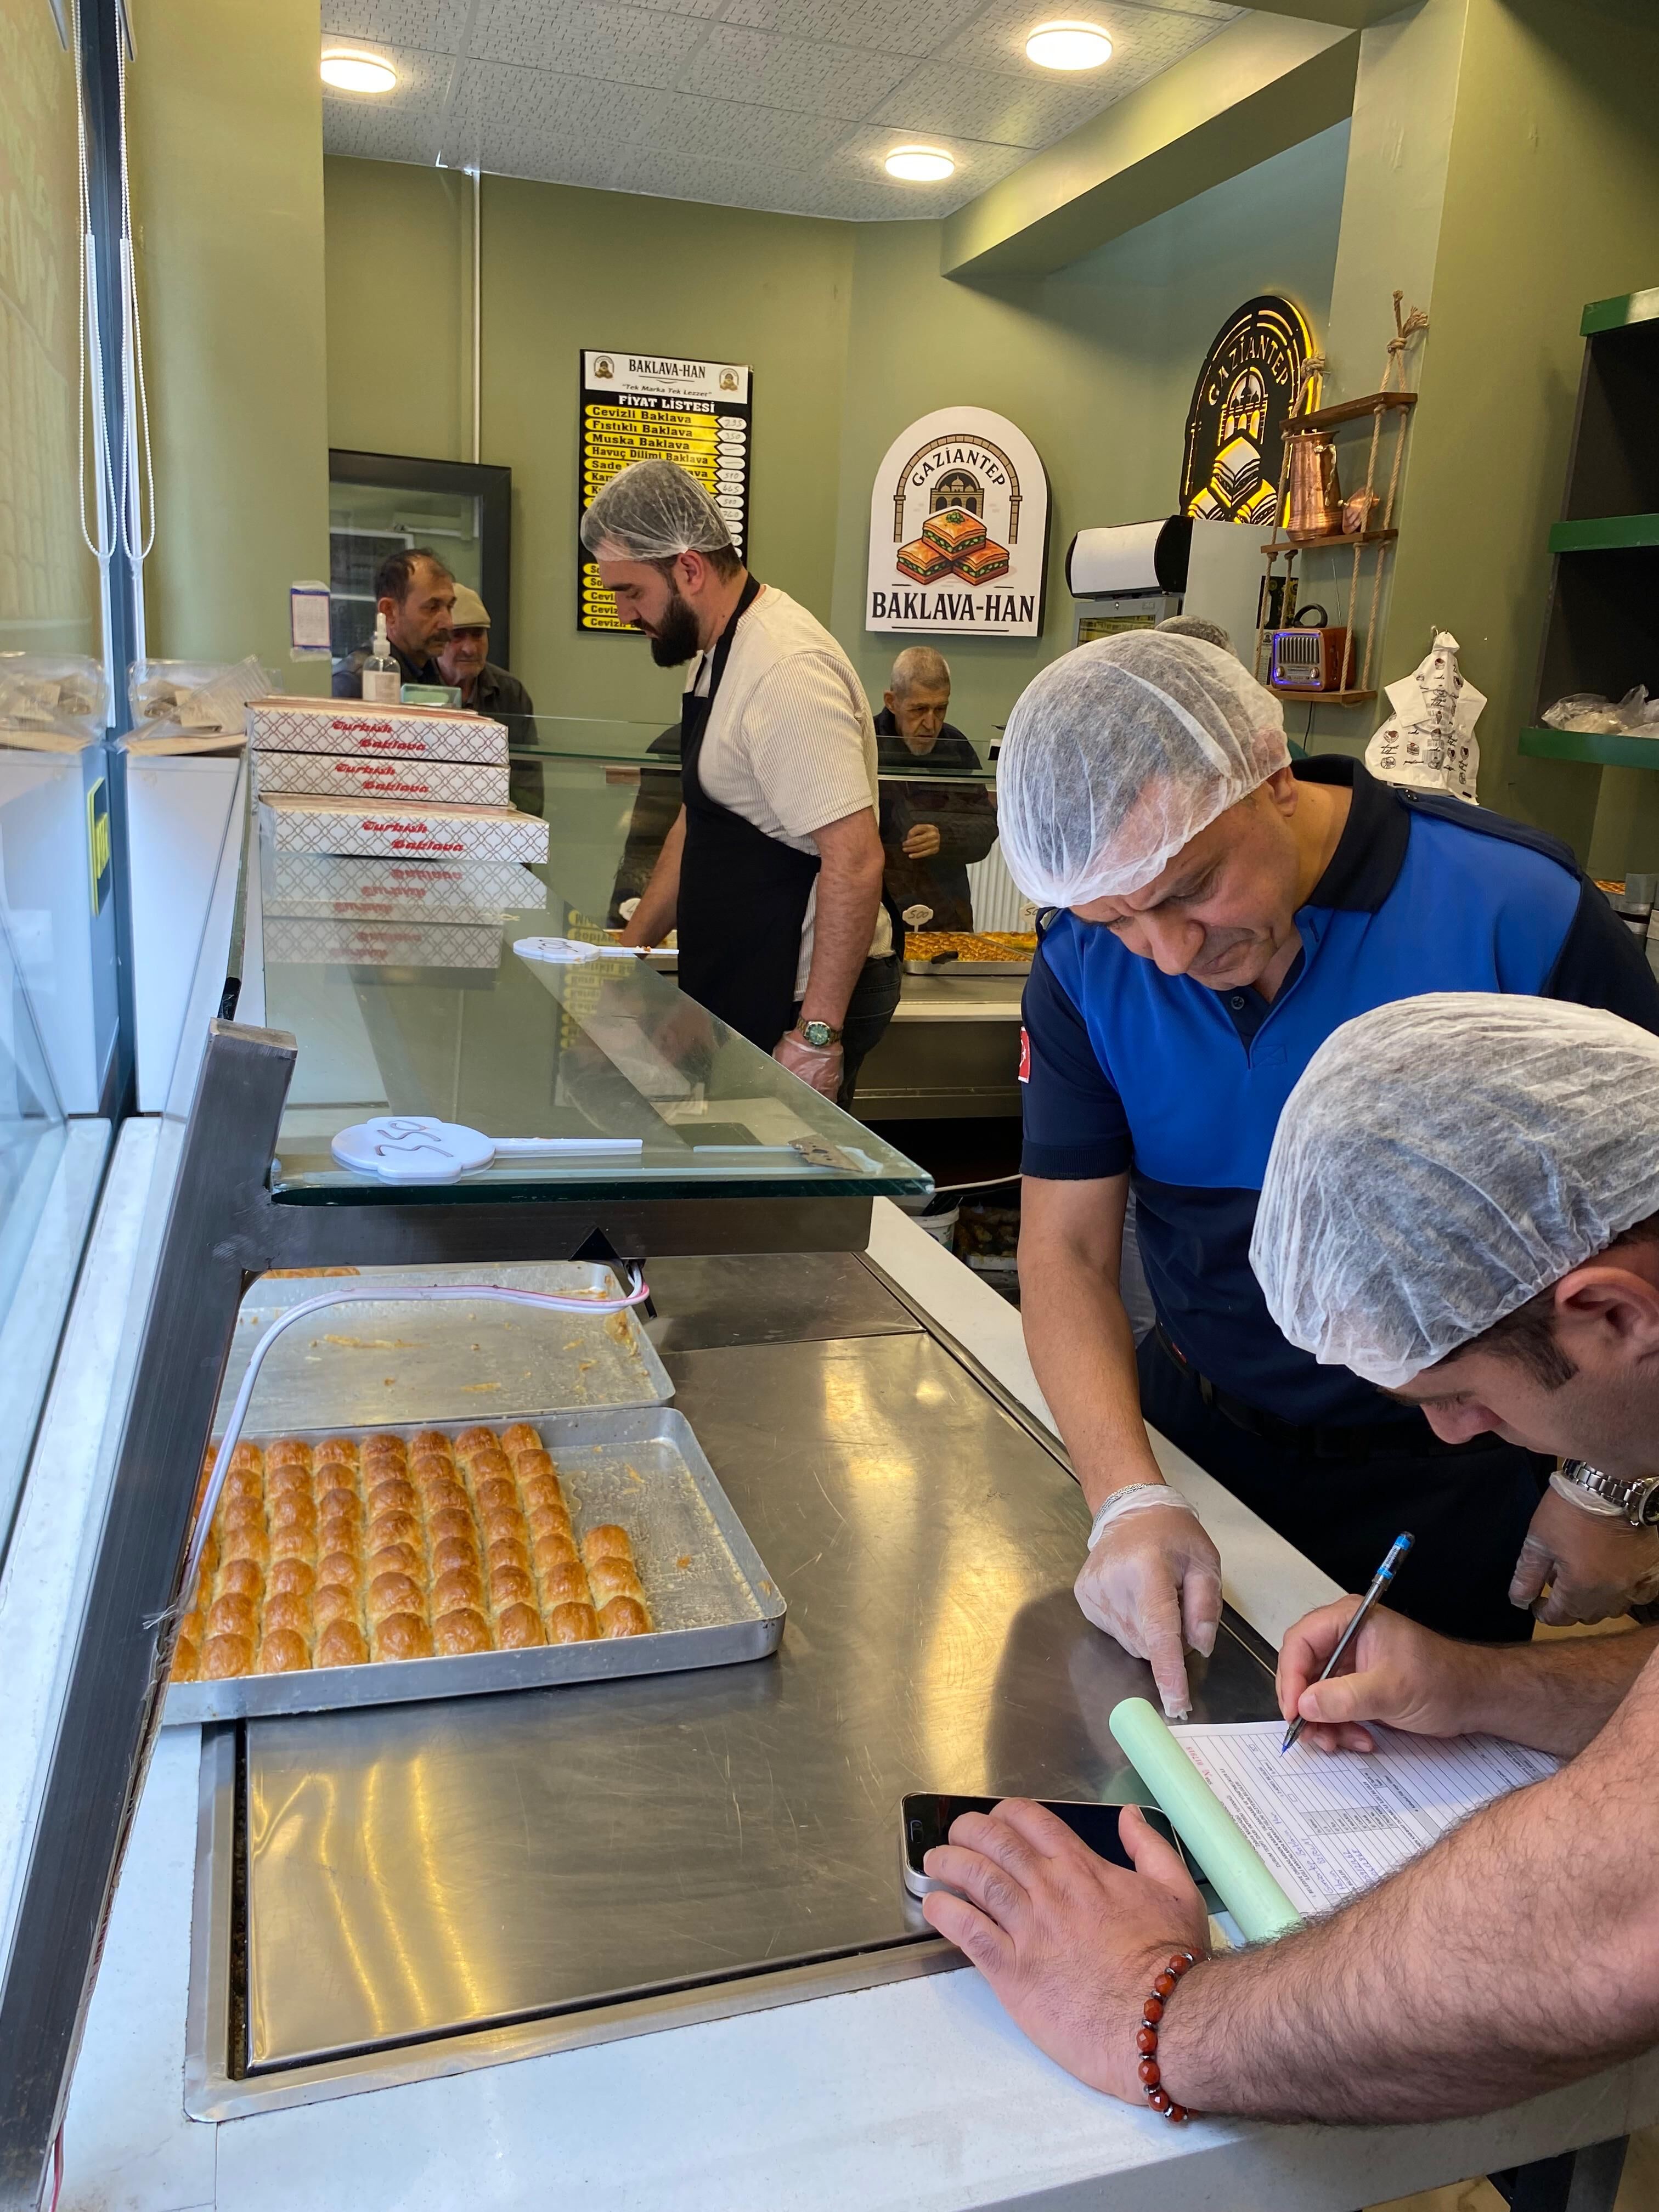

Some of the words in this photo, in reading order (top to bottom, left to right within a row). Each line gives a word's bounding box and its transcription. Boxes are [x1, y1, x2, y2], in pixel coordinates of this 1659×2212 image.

[629, 359, 706, 379] BAKLAVA-HAN
[618, 394, 657, 407] FİYAT
[662, 398, 715, 413] LİSTESİ
[592, 407, 635, 418] Cevizli
[641, 411, 691, 423] Baklava
[592, 420, 637, 432] Fıstıklı
[643, 425, 692, 437] Baklava
[592, 434, 634, 445] Muska
[640, 437, 690, 450] Baklava
[592, 447, 626, 459] Havuç
[630, 449, 661, 460] Dilimi
[666, 453, 708, 464] Baklava
[592, 460, 622, 470] Sade
[912, 447, 1006, 487] GAZİANTEP
[871, 591, 1035, 622] BAKLAVA-HAN
[332, 720, 392, 733] Turkish
[360, 739, 426, 751] Baklava
[335, 763, 396, 775] Turkish
[363, 781, 430, 793] Baklava
[363, 821, 428, 833] Turkish
[391, 839, 464, 851] Baklava
[907, 910, 929, 919] 500
[1025, 907, 1039, 916] 50
